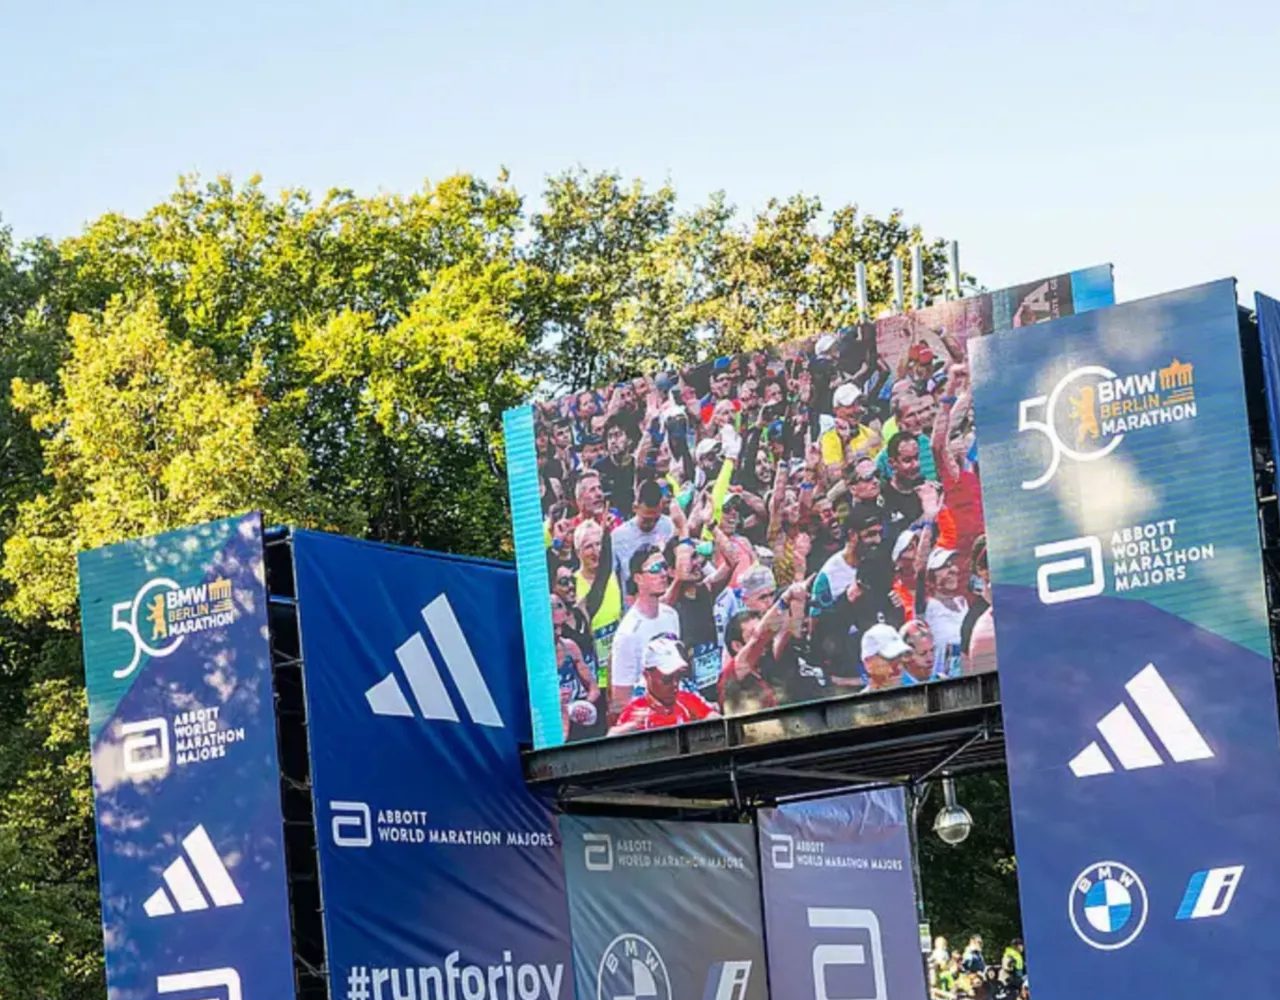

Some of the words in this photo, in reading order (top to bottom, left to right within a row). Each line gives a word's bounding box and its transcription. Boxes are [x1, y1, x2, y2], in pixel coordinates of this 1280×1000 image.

[1098, 370, 1157, 404] BMW
[1100, 394, 1161, 419] BERLIN
[1102, 402, 1198, 437] MARATHON
[1110, 519, 1177, 545] ABBOTT
[1112, 537, 1173, 560] WORLD
[1114, 544, 1215, 577] MARATHON
[1115, 566, 1187, 593] MAJORS
[166, 584, 208, 609] BMW
[168, 603, 209, 622] BERLIN
[169, 611, 234, 636] MARATHON
[174, 706, 220, 726] ABBOTT
[175, 721, 217, 738] WORLD
[176, 728, 245, 751] MARATHON
[176, 745, 226, 765] MAJORS
[377, 810, 428, 826] ABBOTT
[378, 827, 425, 843] WORLD
[428, 830, 501, 846] MARATHON
[506, 832, 554, 847] MAJORS
[1078, 865, 1135, 894] BMW
[606, 938, 659, 974] BMW
